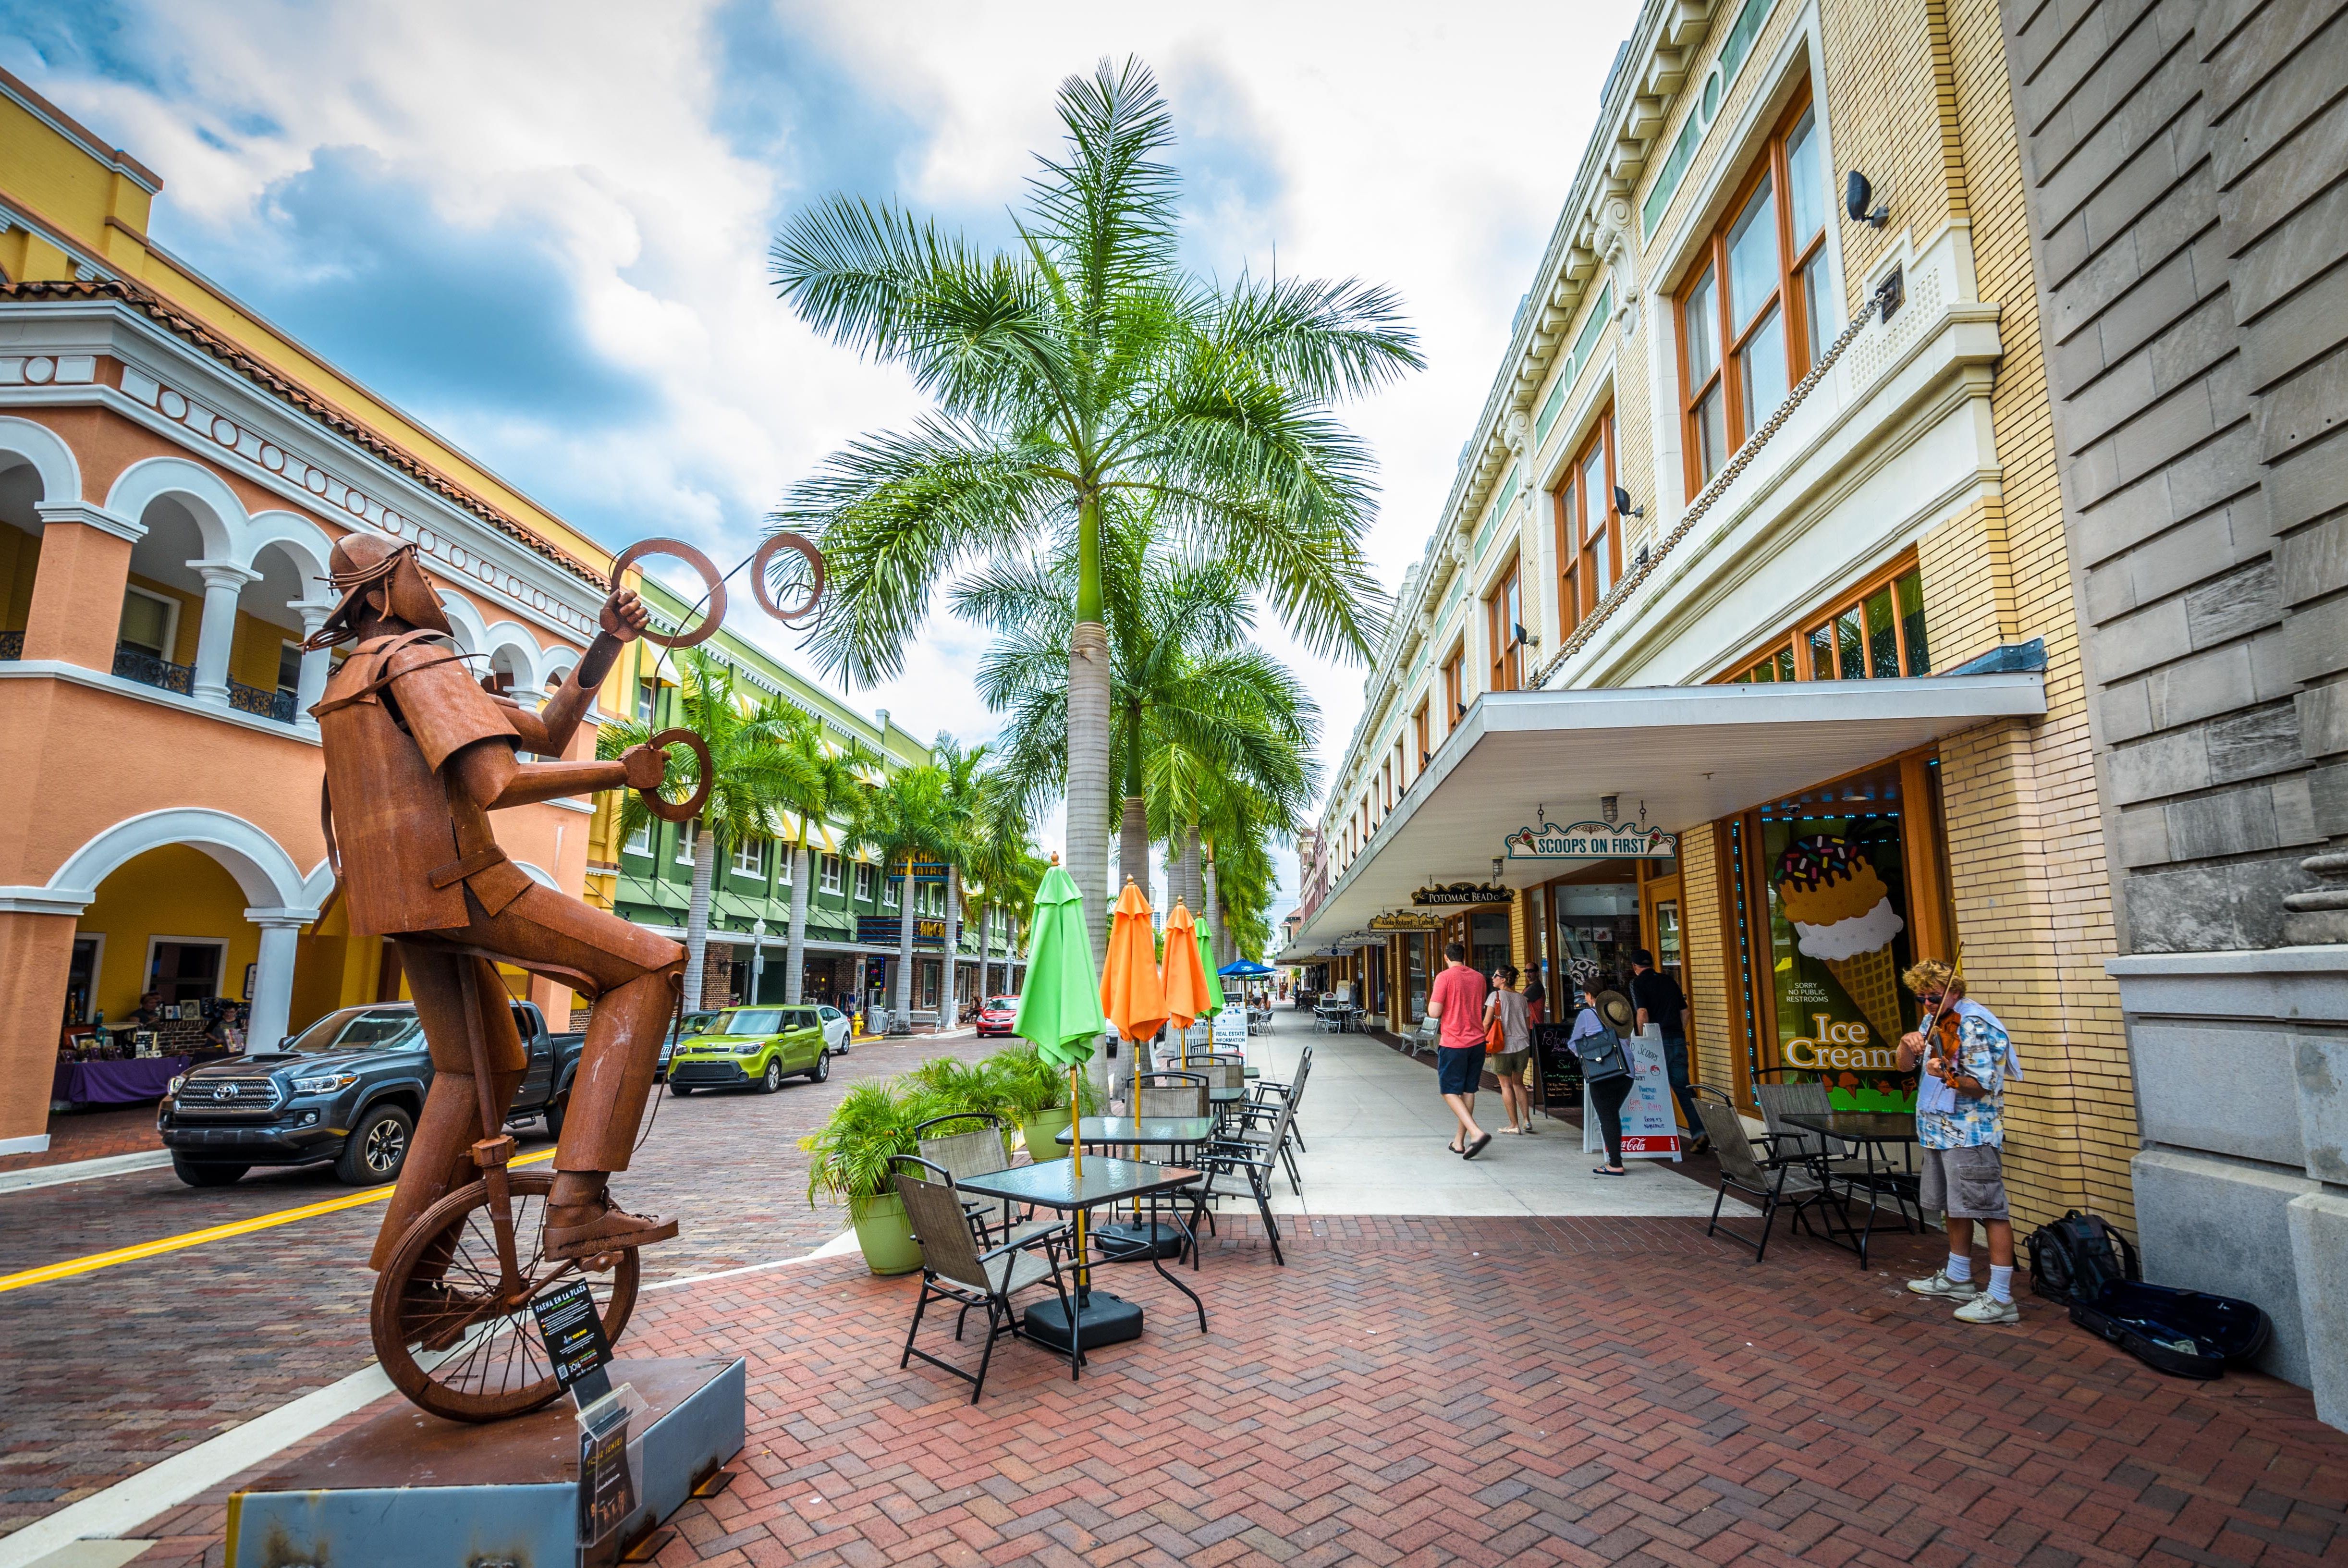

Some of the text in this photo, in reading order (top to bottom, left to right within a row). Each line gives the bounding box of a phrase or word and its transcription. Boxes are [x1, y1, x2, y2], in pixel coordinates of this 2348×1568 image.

[1538, 838, 1646, 854] SCOOPS ON FIRST
[894, 867, 943, 876] THATRE
[1429, 894, 1469, 903] POTOMAC
[1472, 892, 1493, 901] BEAD
[1542, 1030, 1568, 1045] Potom
[1815, 1016, 1866, 1043] Ice
[1786, 1040, 1897, 1068] Cream
[536, 1299, 553, 1313] FAENA
[554, 1296, 563, 1304] EN
[562, 1292, 570, 1300] LA
[570, 1285, 587, 1297] PLAZA
[569, 1361, 581, 1372] 2016
[605, 1435, 623, 1455] SENSES
